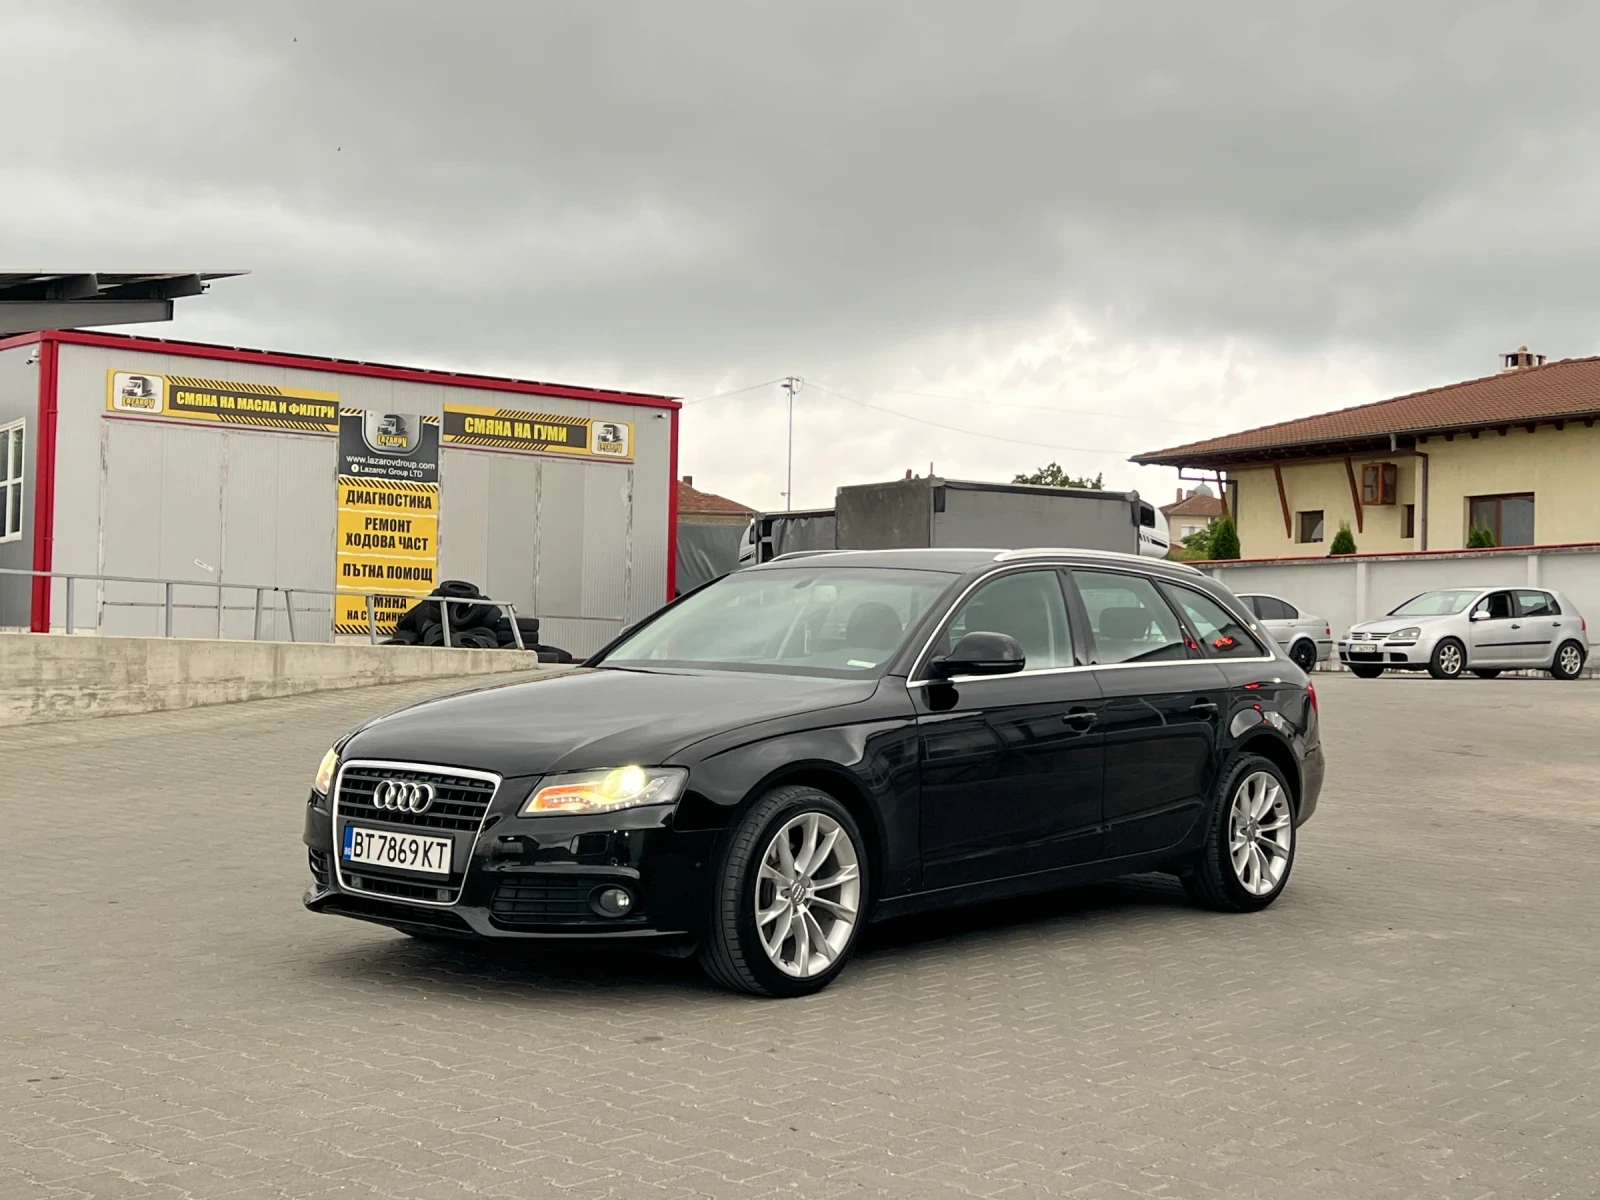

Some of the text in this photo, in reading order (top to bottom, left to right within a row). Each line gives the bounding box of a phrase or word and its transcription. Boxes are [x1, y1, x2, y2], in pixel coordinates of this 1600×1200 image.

[176, 391, 335, 418] СМЯНА НА МАСЛА И ФИЛТРИ
[464, 417, 567, 442] СМЯНА НА ГУМИ
[360, 465, 423, 478] Lazarov Group LTD
[345, 490, 432, 509] ДИАГНОСТИКА
[365, 517, 412, 533] РЕМОНТ
[345, 532, 428, 551] ХОДОВА ЧАСТ
[343, 563, 432, 583] ПЪТНА ПОМОЩ
[347, 610, 359, 620] НА
